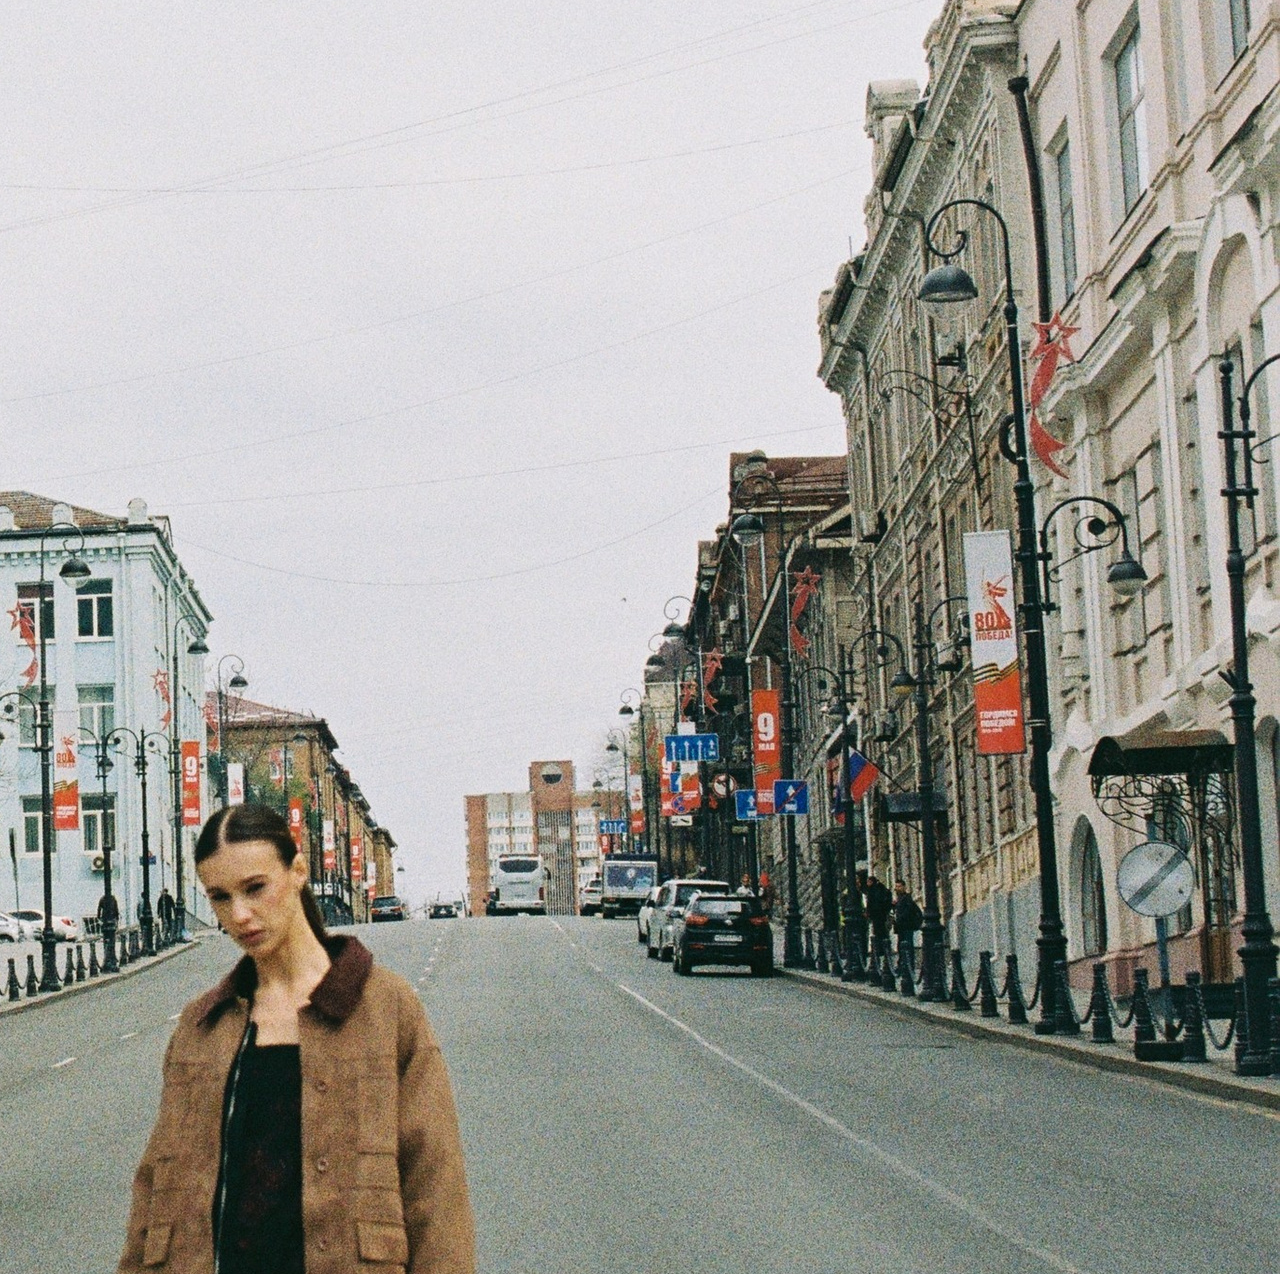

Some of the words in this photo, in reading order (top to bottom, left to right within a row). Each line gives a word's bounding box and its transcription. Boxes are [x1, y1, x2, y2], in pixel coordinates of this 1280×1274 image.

[975, 612, 995, 630] 80
[975, 630, 1013, 641] ПОБЕДА!
[758, 712, 774, 742] 9
[185, 756, 197, 776] 9
